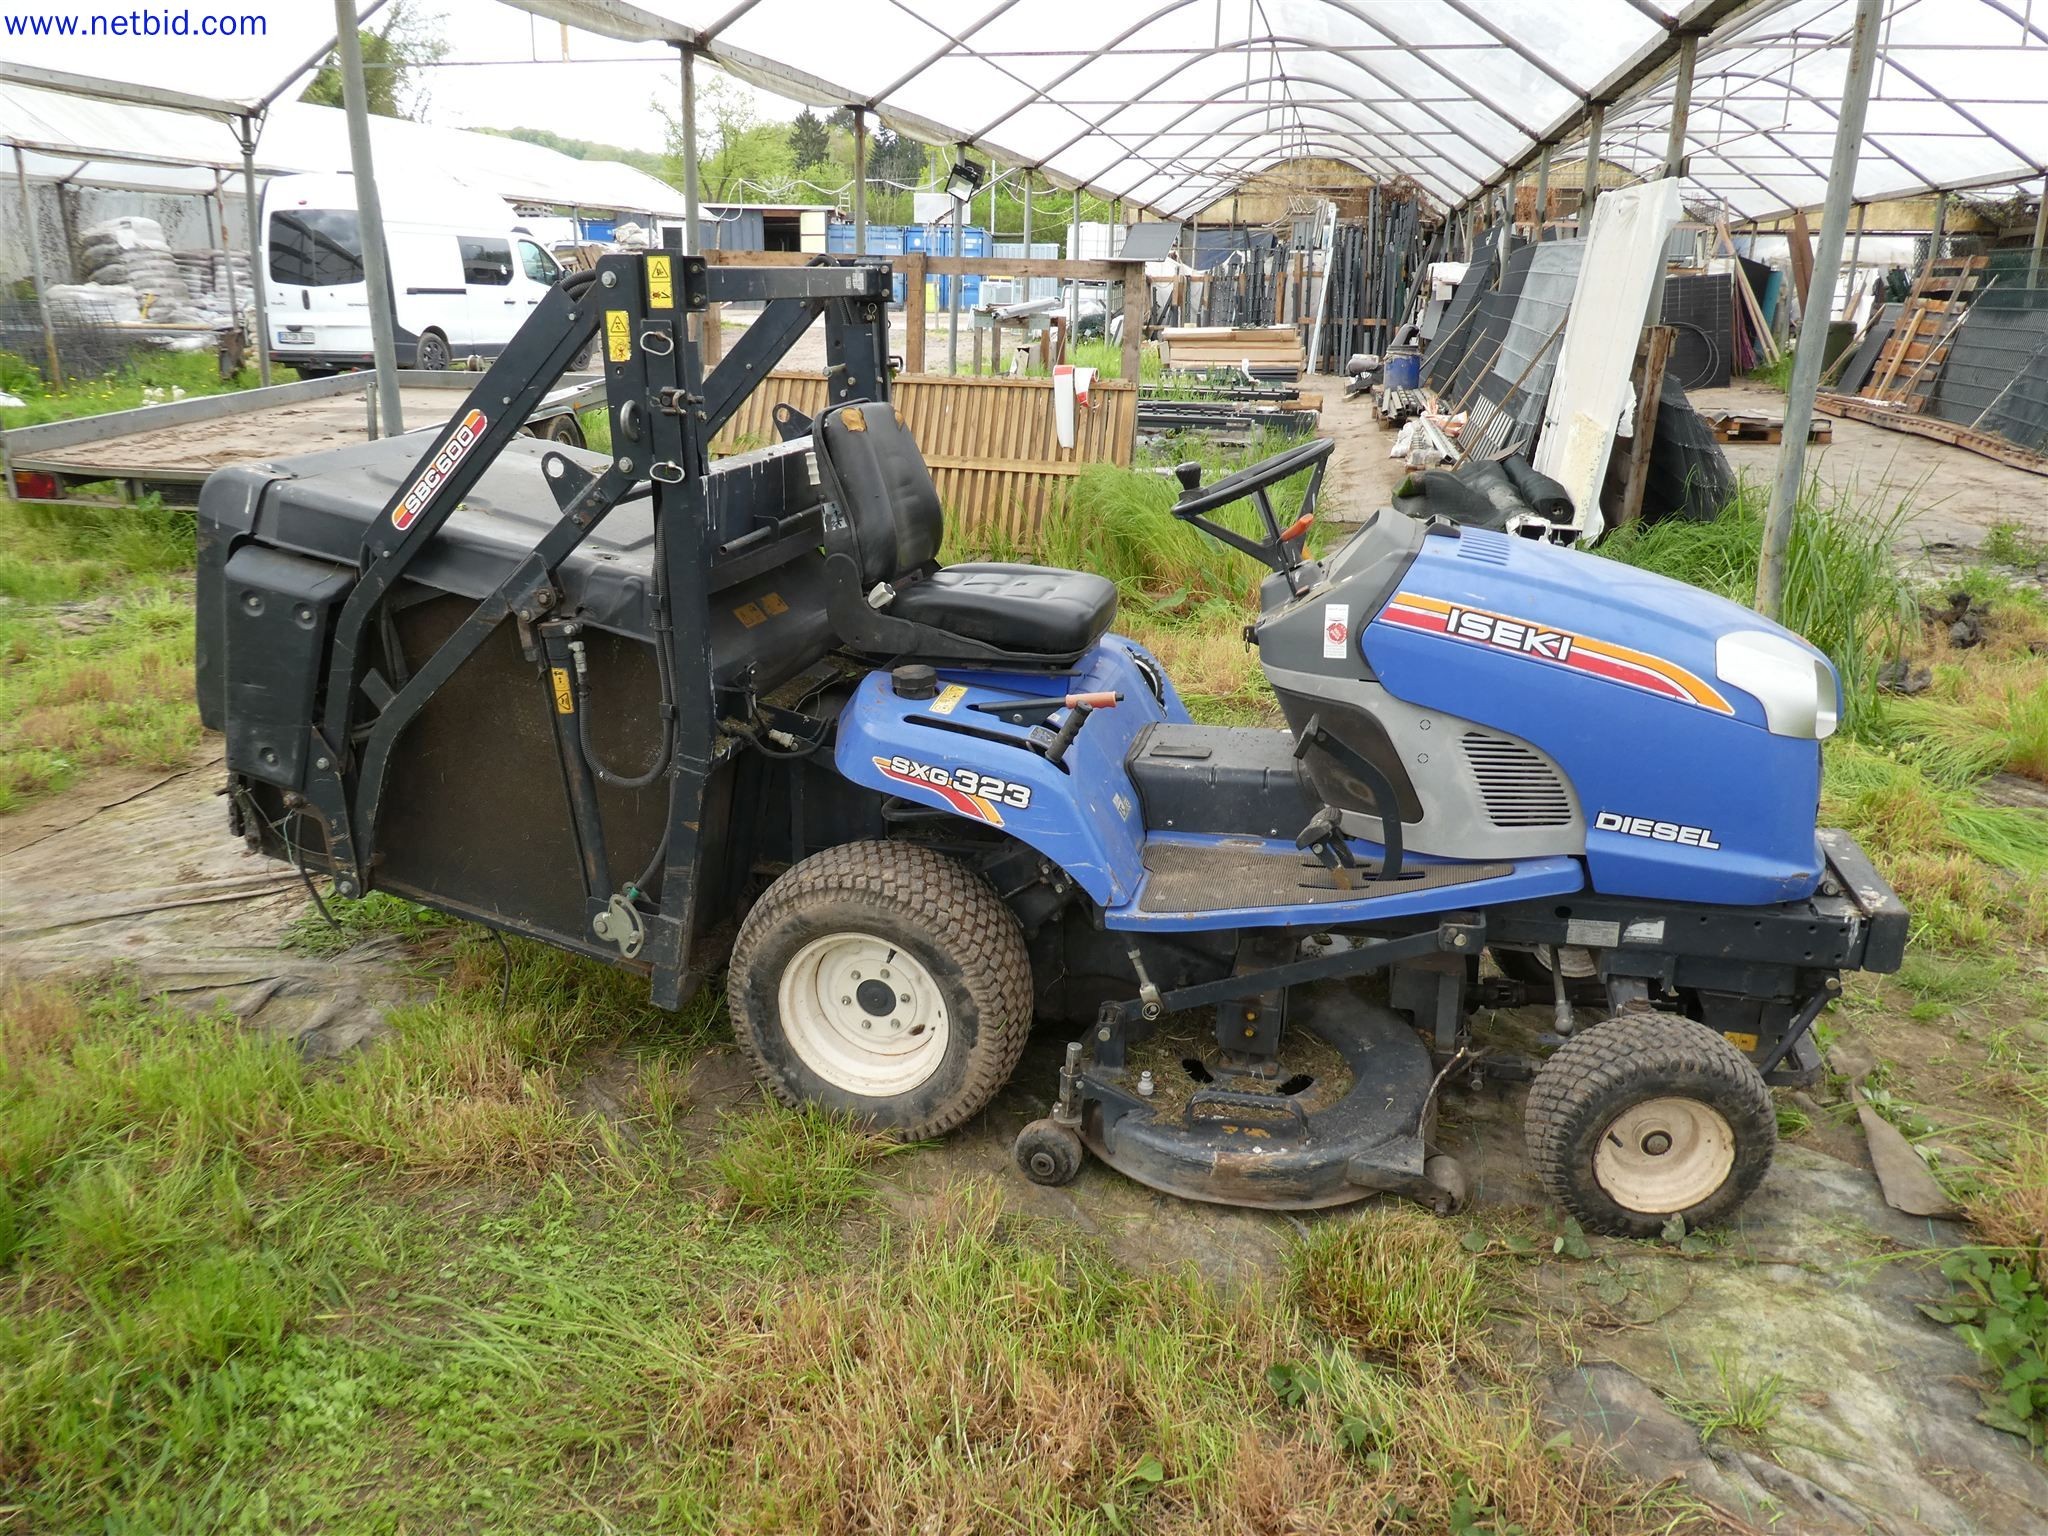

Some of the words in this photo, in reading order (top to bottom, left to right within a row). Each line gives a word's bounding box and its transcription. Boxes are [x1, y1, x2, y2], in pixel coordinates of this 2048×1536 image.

[404, 468, 441, 514] SBC
[435, 425, 475, 475] 600
[1445, 607, 1574, 662] ISEKI
[890, 755, 951, 787] SXG
[952, 767, 1032, 809] 323
[1595, 811, 1721, 850] DIESEL
